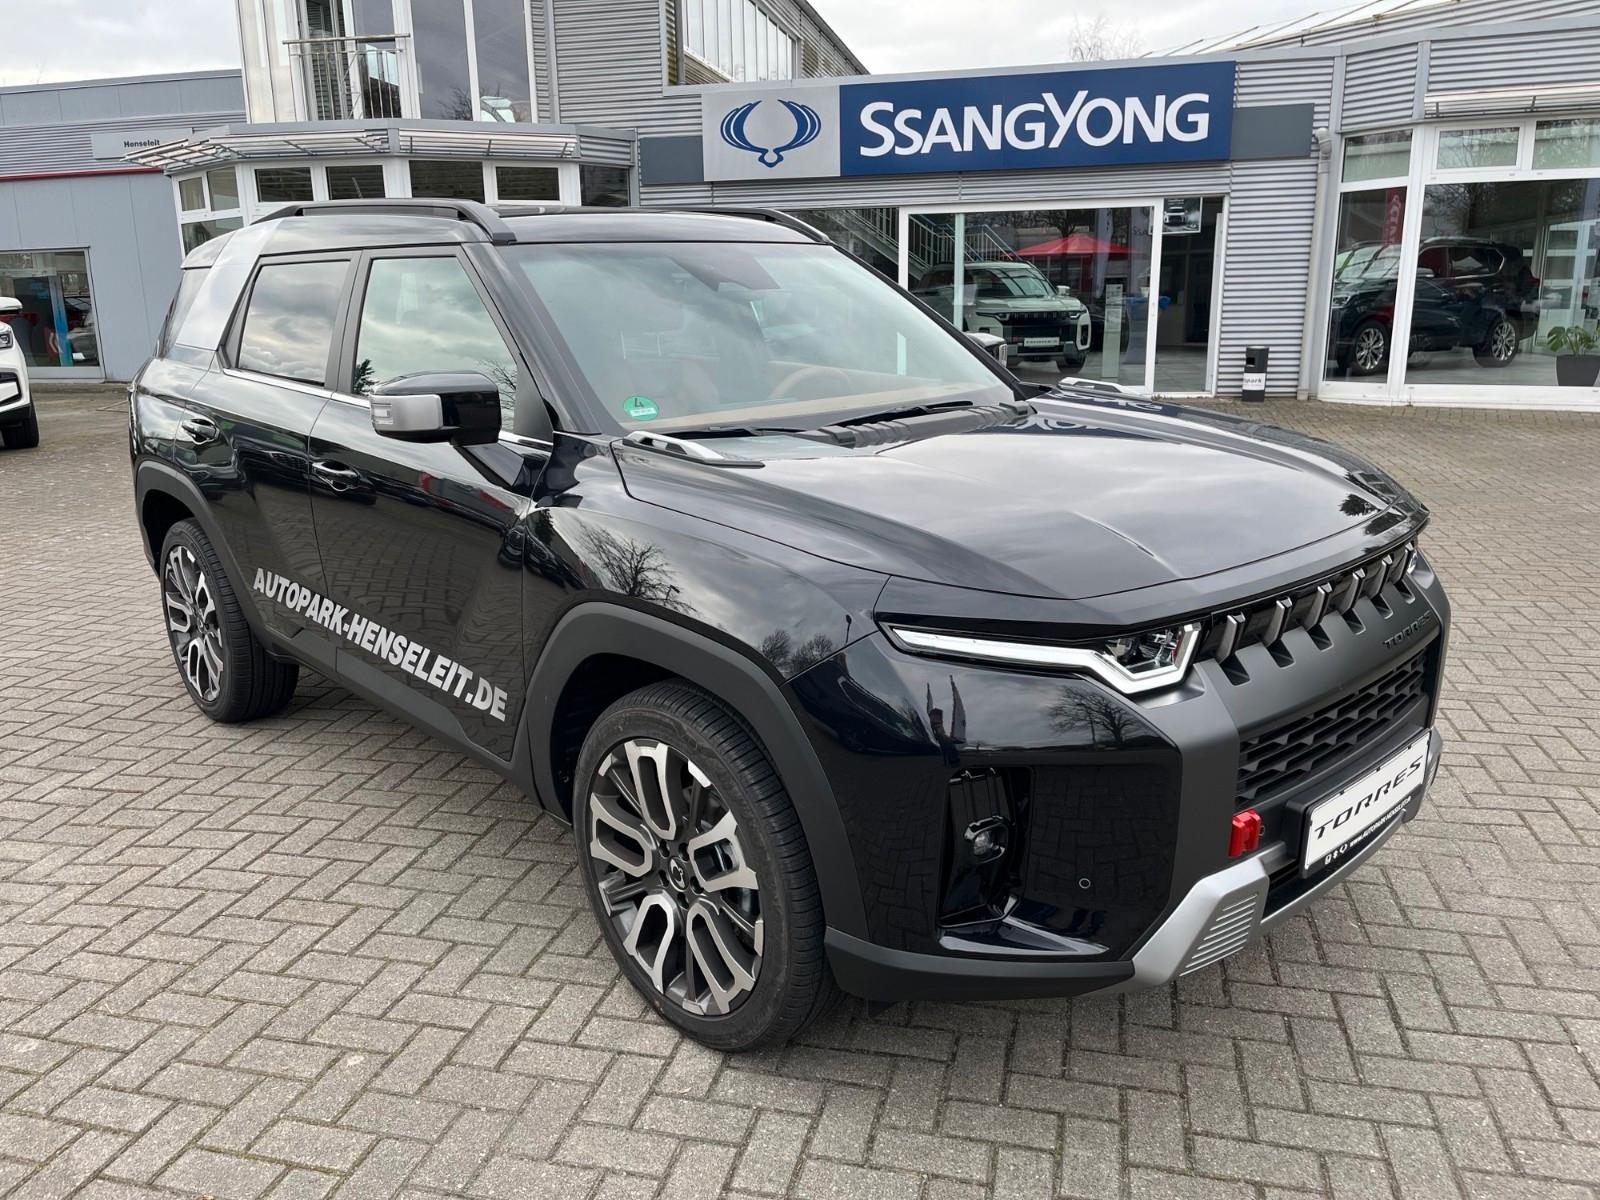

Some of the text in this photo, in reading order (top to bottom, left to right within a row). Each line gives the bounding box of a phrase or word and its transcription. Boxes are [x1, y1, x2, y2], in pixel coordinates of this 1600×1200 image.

[123, 139, 161, 148] Henseleit
[860, 90, 1210, 157] SSANGYONG
[634, 397, 645, 408] 4
[253, 567, 508, 722] AUTOPARK-HENSELEIT.DE
[1382, 610, 1432, 649] TORRES
[1313, 755, 1424, 841] TORRES
